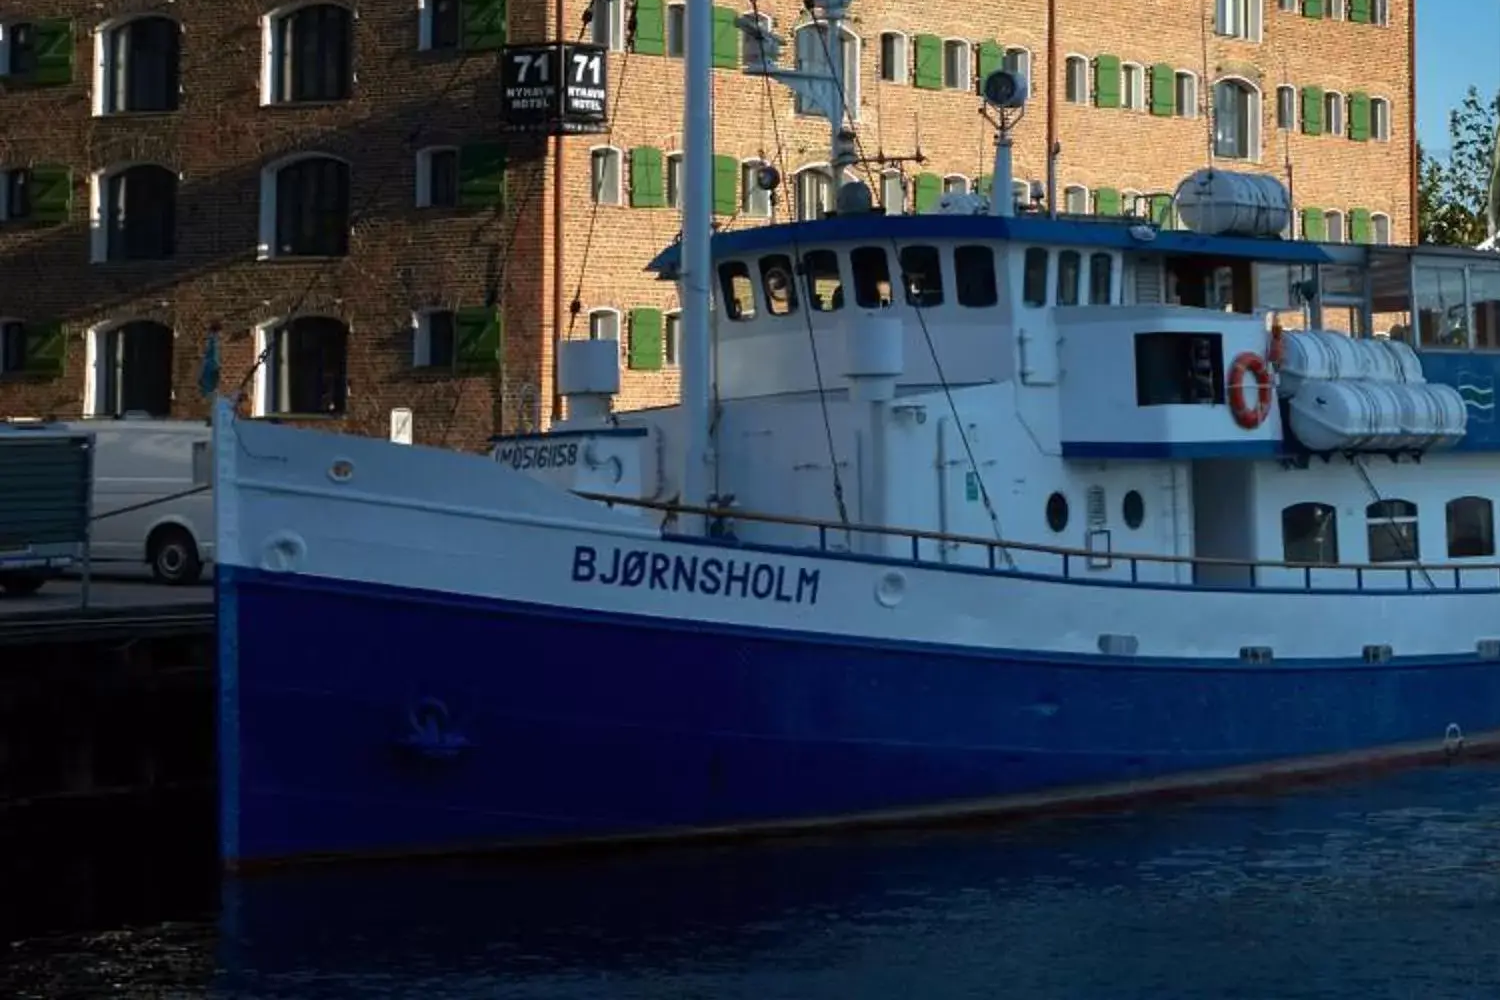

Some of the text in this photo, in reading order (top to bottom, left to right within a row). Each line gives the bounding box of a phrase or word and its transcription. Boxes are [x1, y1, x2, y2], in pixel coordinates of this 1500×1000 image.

[513, 54, 548, 82] 71
[573, 54, 600, 84] 71
[512, 99, 549, 109] HOTEL
[571, 99, 602, 111] HOTEL
[572, 546, 820, 605] BJØRNSHOLM
